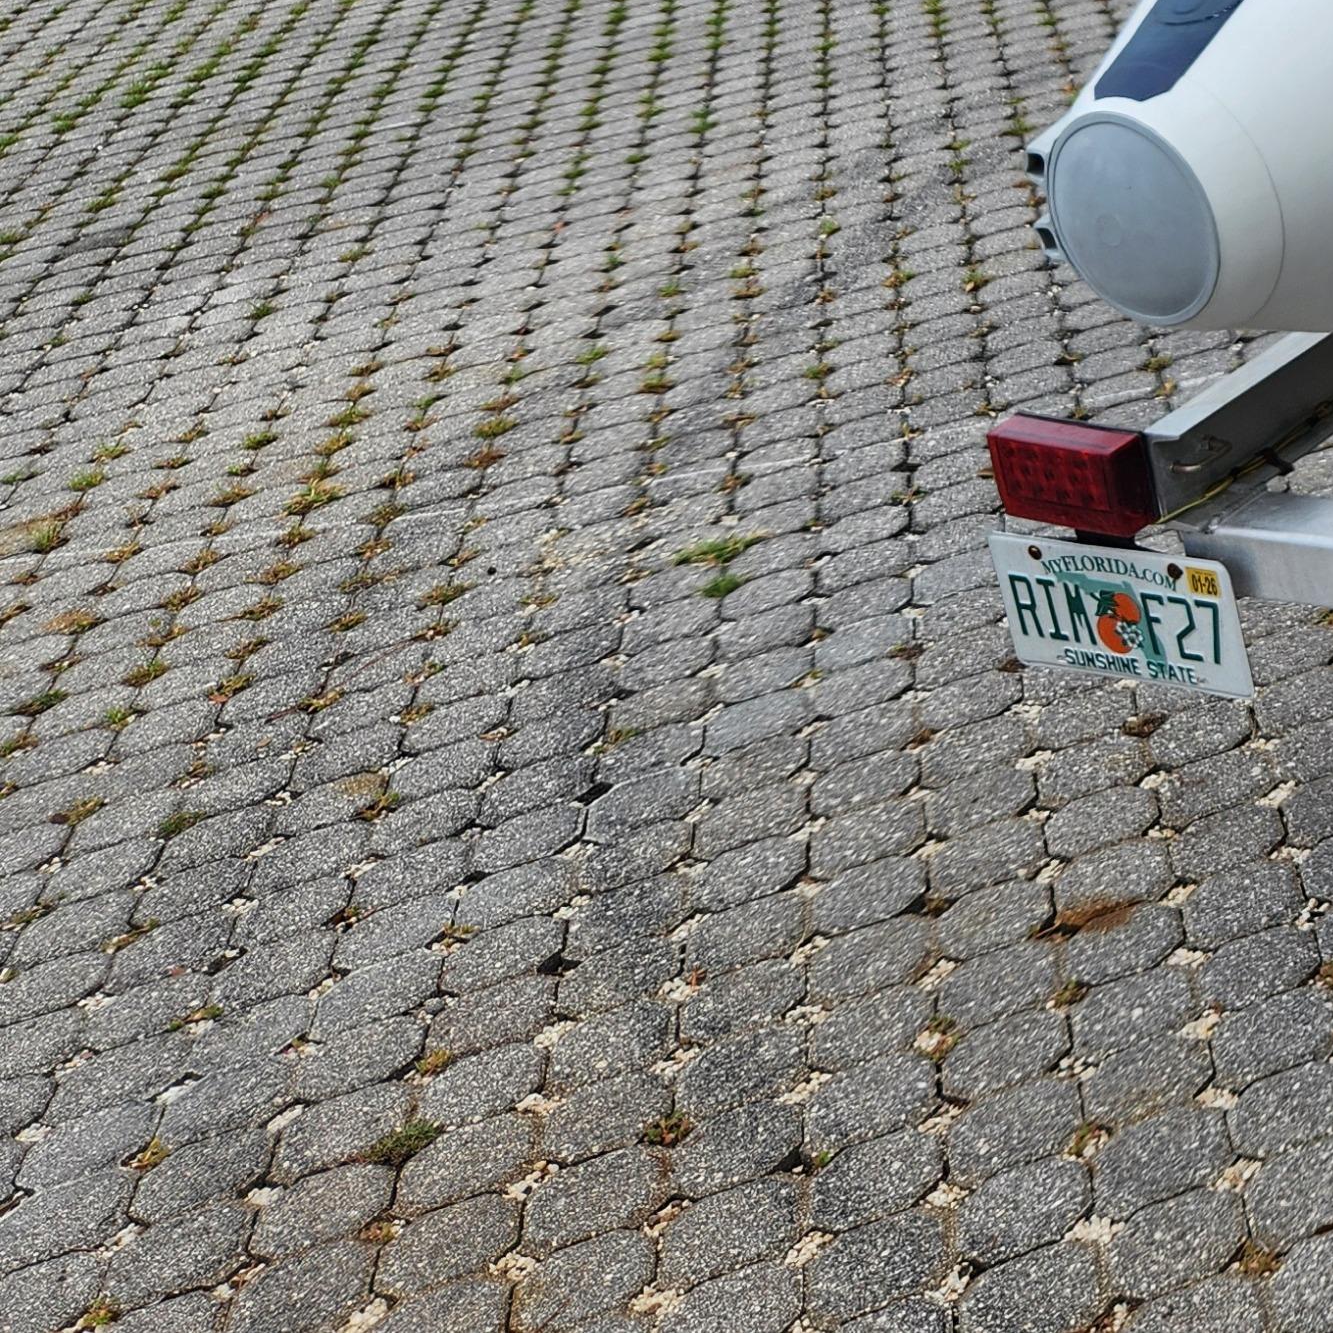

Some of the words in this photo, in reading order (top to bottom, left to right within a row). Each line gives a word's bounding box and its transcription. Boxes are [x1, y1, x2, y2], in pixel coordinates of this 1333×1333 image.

[1041, 555, 1177, 592] MYFLORIDA.COM
[1191, 573, 1218, 596] 01-26
[1008, 573, 1098, 646] RIM
[1140, 592, 1222, 664] F27
[1064, 647, 1140, 676] SUNSHINE
[1149, 660, 1198, 685] STATE
